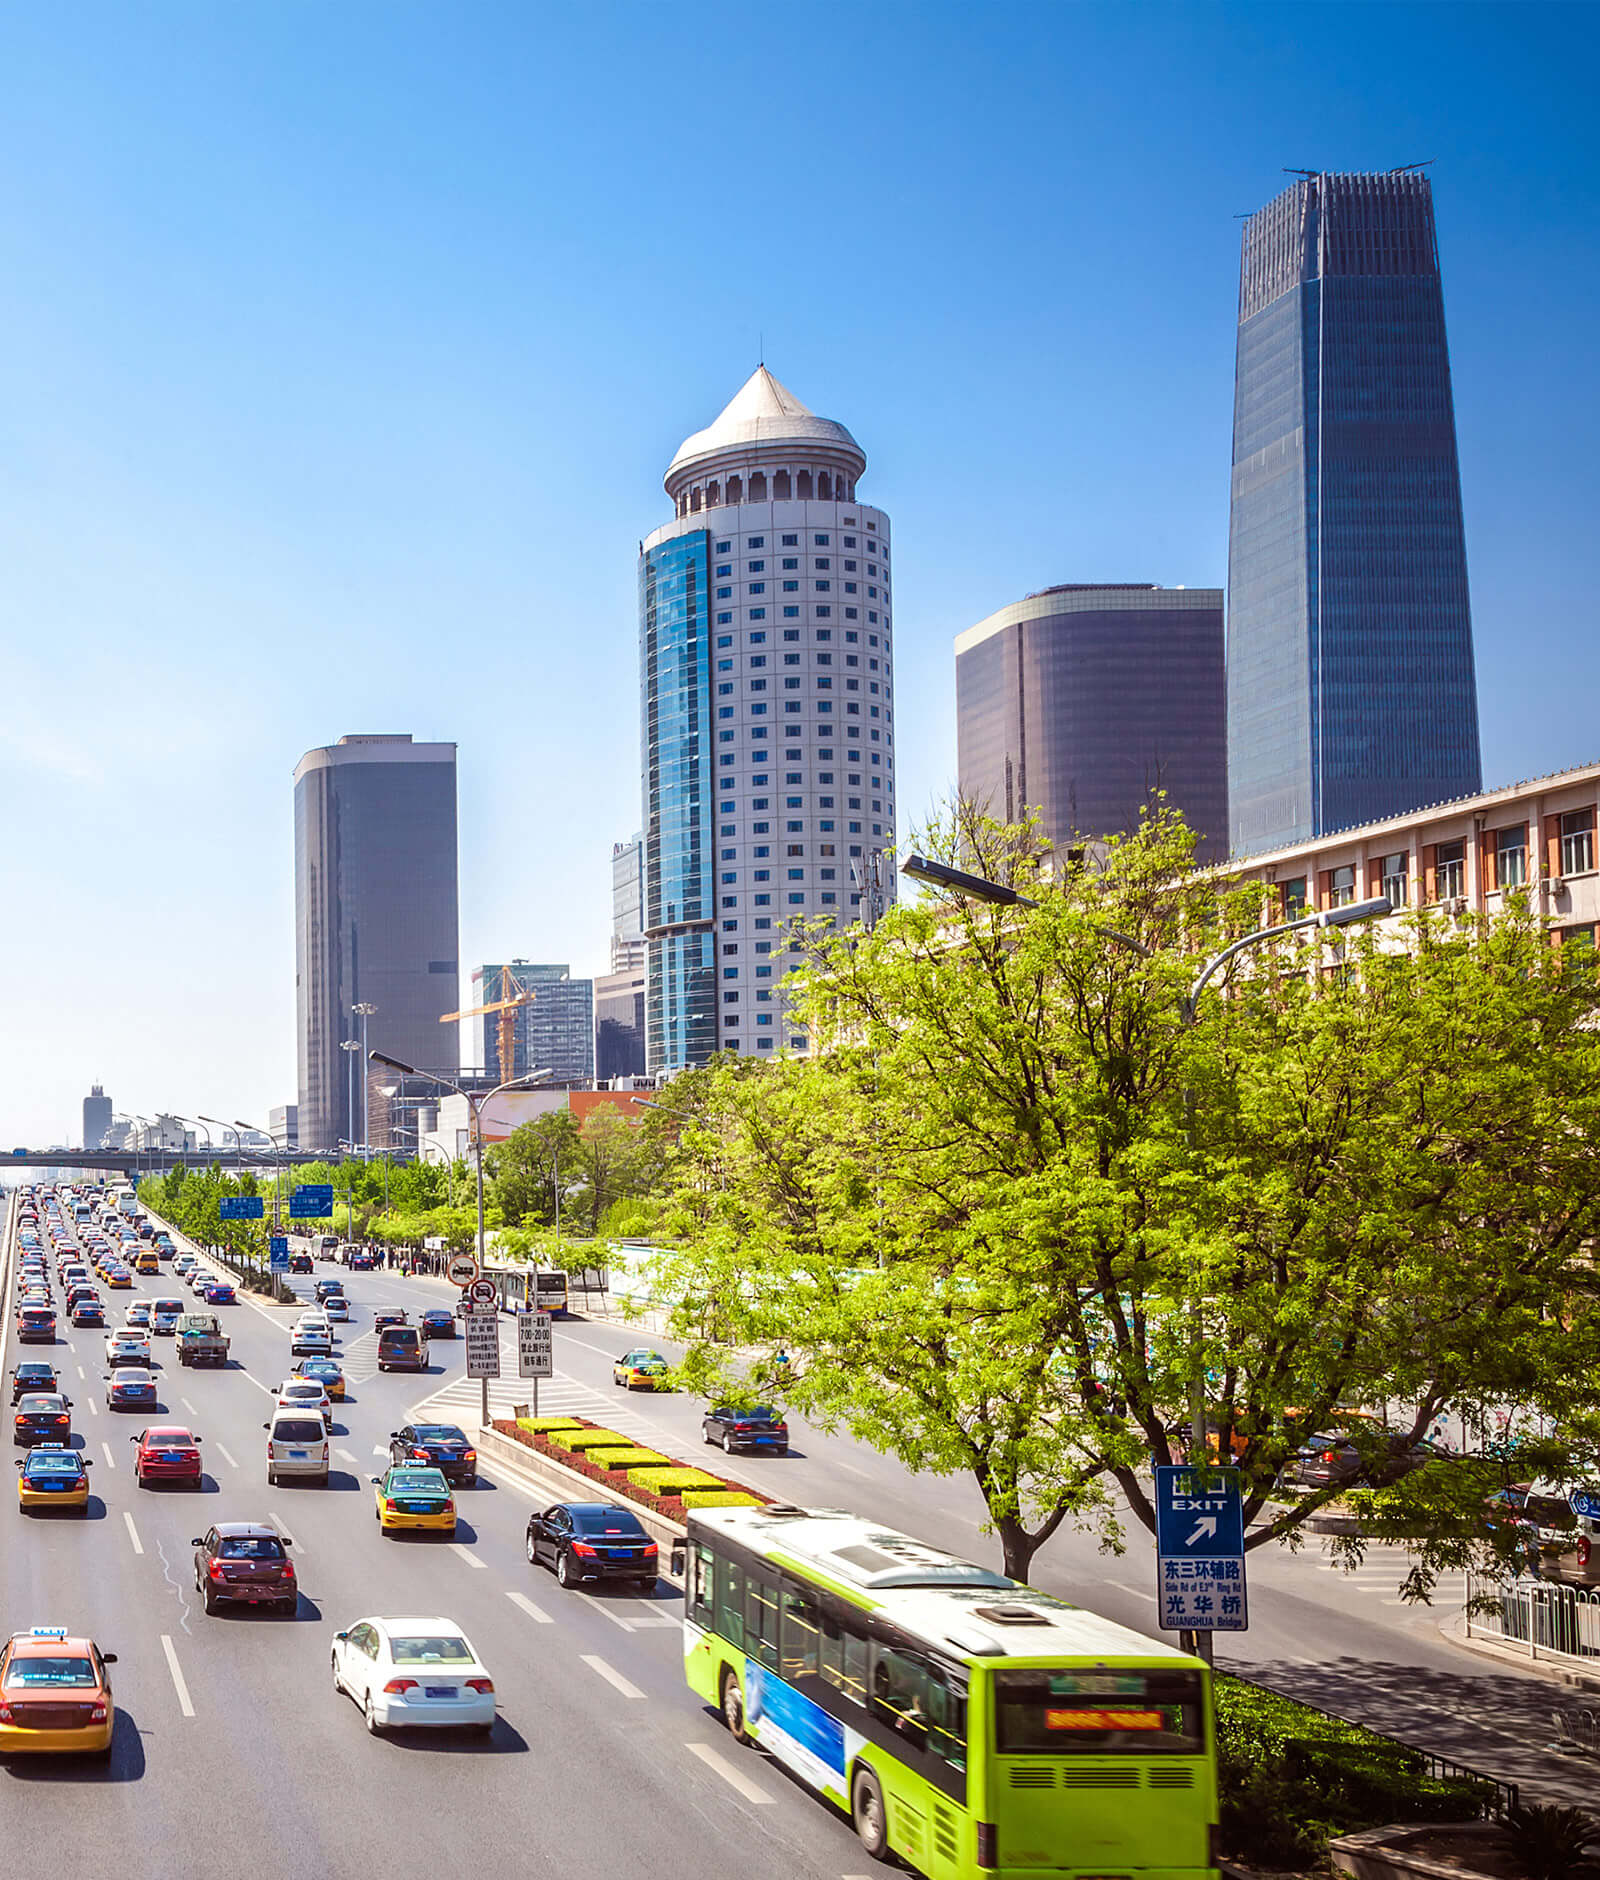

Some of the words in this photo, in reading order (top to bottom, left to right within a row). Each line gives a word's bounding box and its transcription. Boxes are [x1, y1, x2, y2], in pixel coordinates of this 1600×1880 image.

[1172, 1500, 1228, 1510] EXIT
[1165, 1560, 1240, 1580] 东三环辅路
[1165, 1582, 1178, 1592] Side
[1180, 1582, 1189, 1592] Rd
[1190, 1582, 1197, 1592] of
[1217, 1582, 1231, 1594] Ring
[1233, 1582, 1241, 1592] Rd
[1166, 1595, 1241, 1614] 光华桥
[1166, 1616, 1214, 1626] GUANGHUA
[1217, 1616, 1242, 1628] Bridge
